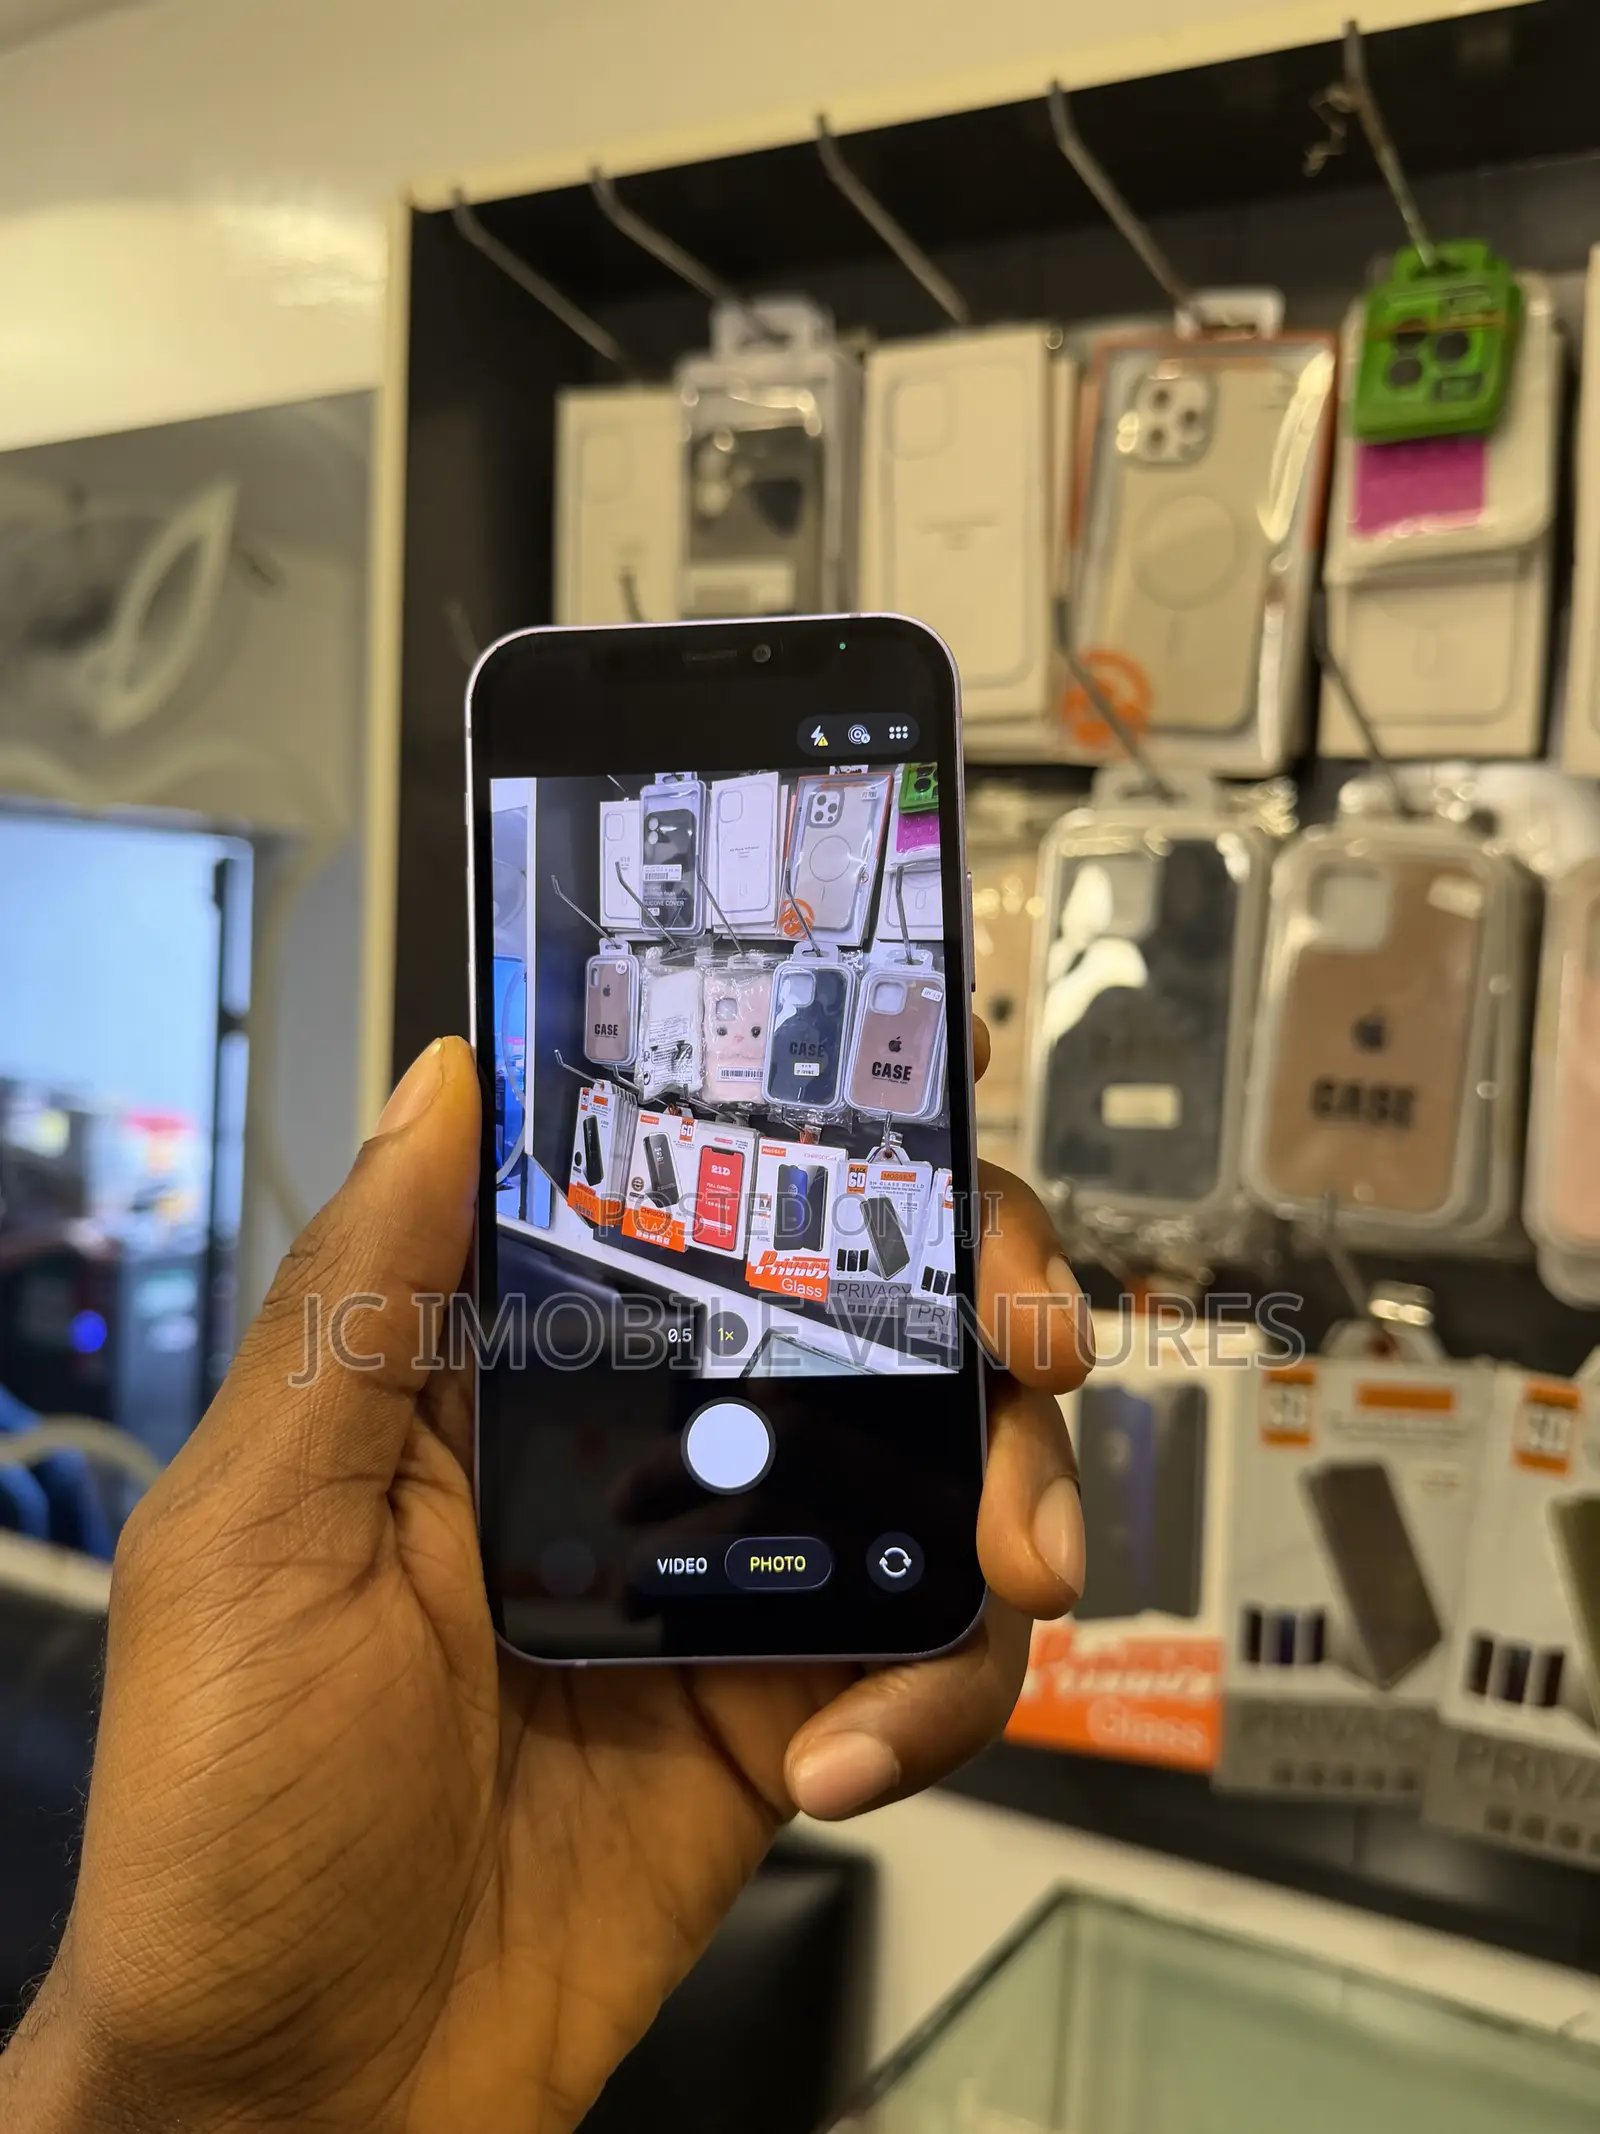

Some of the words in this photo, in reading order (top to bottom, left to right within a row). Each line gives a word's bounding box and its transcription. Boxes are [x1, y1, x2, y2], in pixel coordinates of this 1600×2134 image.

[594, 1024, 619, 1036] CASE
[789, 1041, 825, 1058] CASE
[872, 1062, 912, 1081] CASE
[848, 1172, 866, 1187] 6D
[781, 1277, 823, 1298] Glass
[837, 1282, 912, 1301] PRIVACY
[668, 1328, 692, 1343] 0.5
[656, 1557, 708, 1575] VIDEO
[750, 1555, 806, 1573] PHOTO
